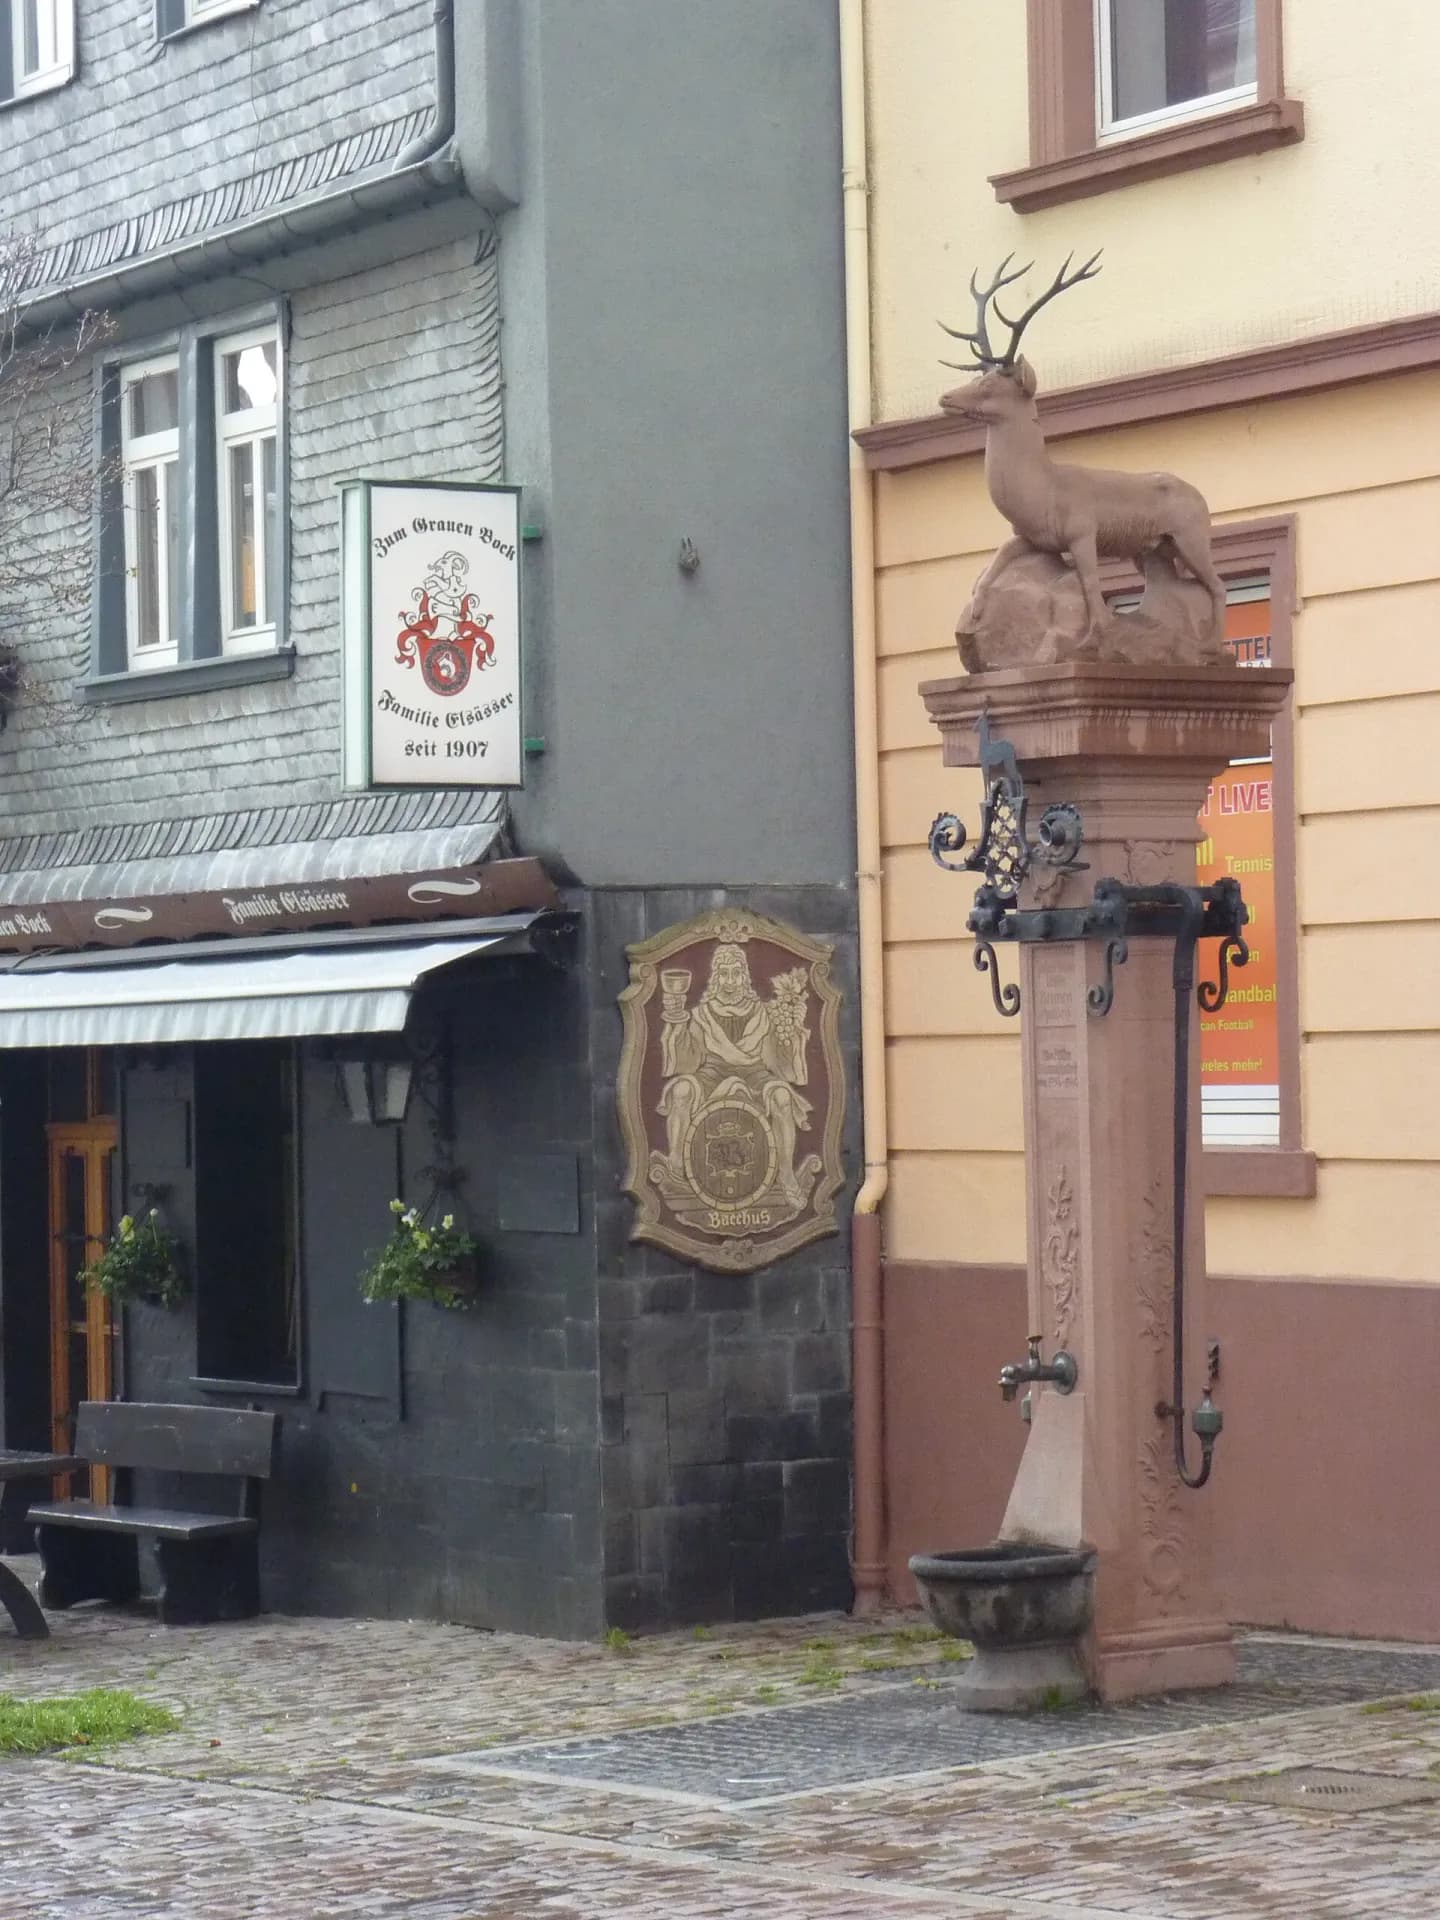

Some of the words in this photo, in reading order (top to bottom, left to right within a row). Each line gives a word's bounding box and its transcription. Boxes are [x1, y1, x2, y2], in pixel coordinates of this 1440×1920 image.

[373, 526, 407, 559] Zum
[412, 516, 474, 537] Grauen
[479, 525, 517, 562] Bock
[377, 689, 440, 728] Familie
[446, 692, 514, 729] Elsässer
[404, 739, 438, 757] seit
[445, 739, 490, 758] 1907
[1225, 854, 1273, 876] Tennis
[222, 893, 282, 924] Familie
[279, 889, 350, 913] Elsässer
[14, 911, 52, 935] Bock
[708, 1209, 771, 1229] Bacchus
